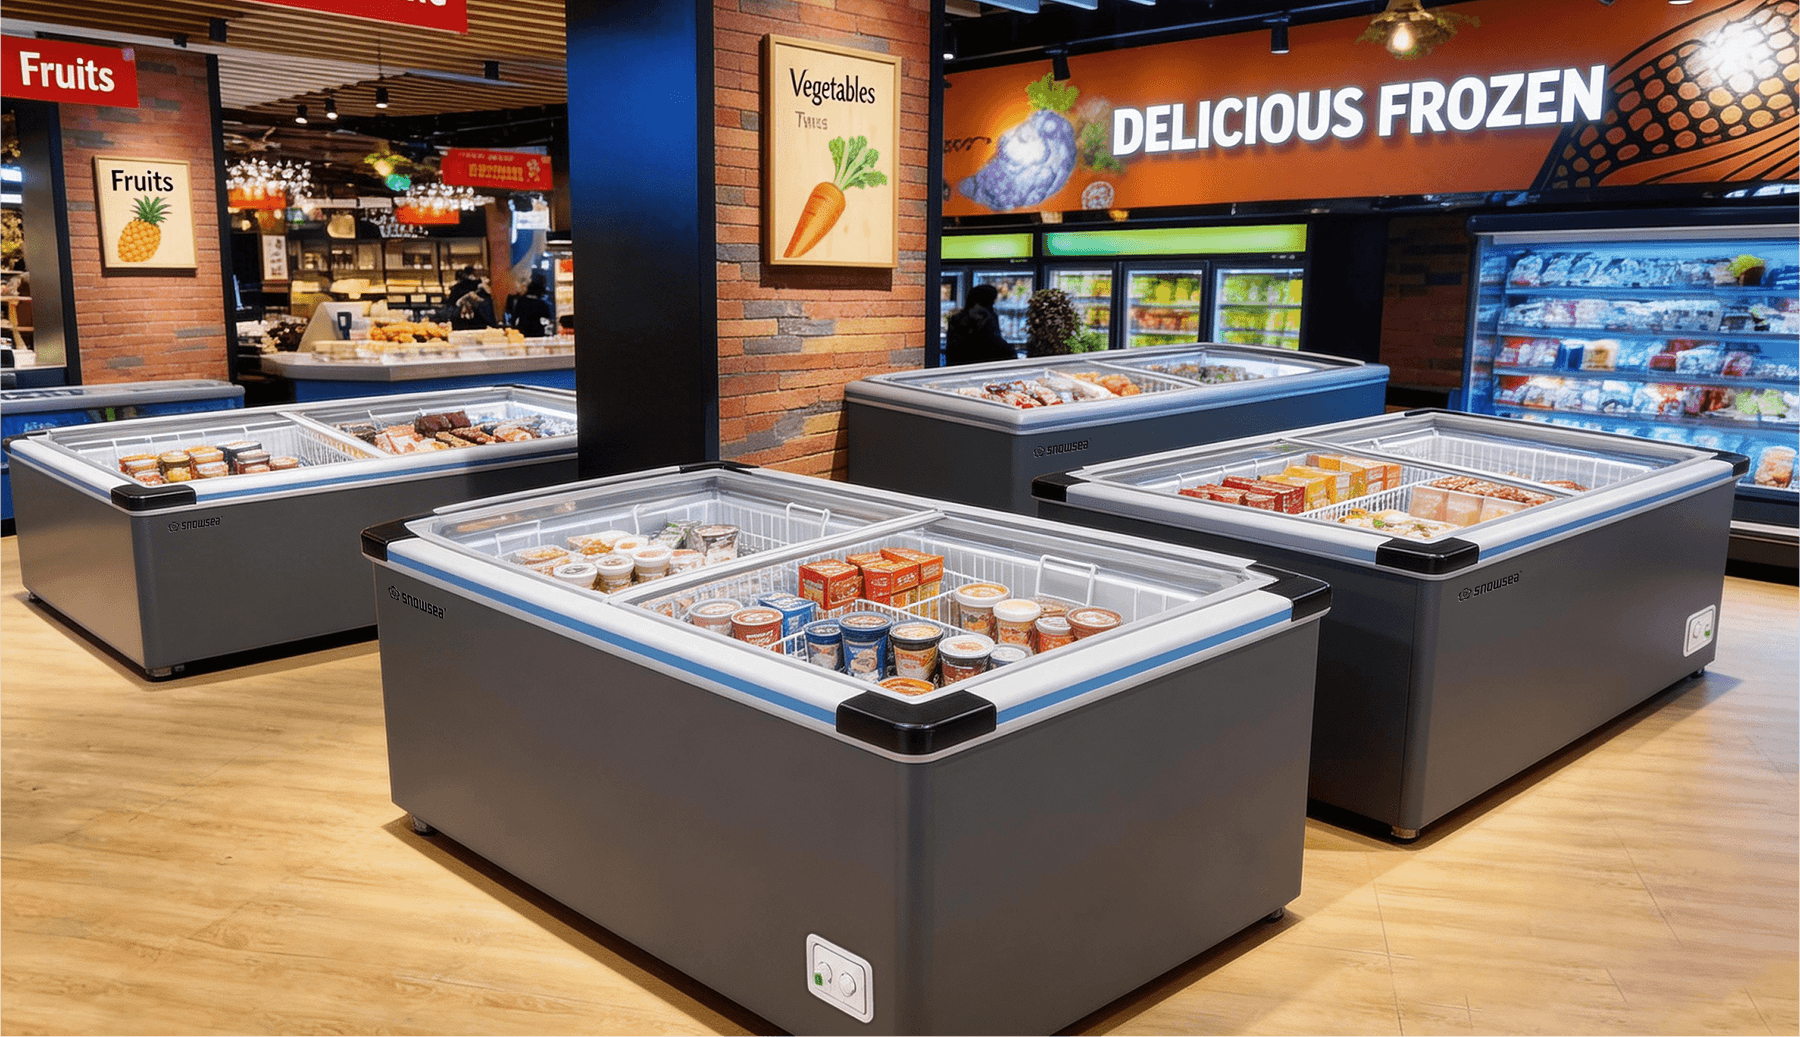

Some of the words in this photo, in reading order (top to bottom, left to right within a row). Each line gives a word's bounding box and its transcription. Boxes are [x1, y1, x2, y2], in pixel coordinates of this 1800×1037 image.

[20, 51, 115, 92] Fruits
[789, 68, 875, 106] Vegetables
[1112, 87, 1364, 155] DELICIOUS
[1379, 65, 1606, 136] FROZEN
[111, 169, 174, 192] Fruits
[1047, 440, 1089, 455] snowsea
[181, 517, 221, 530] snowsea
[1473, 572, 1520, 597] snowsea
[401, 592, 445, 619] snowsea
